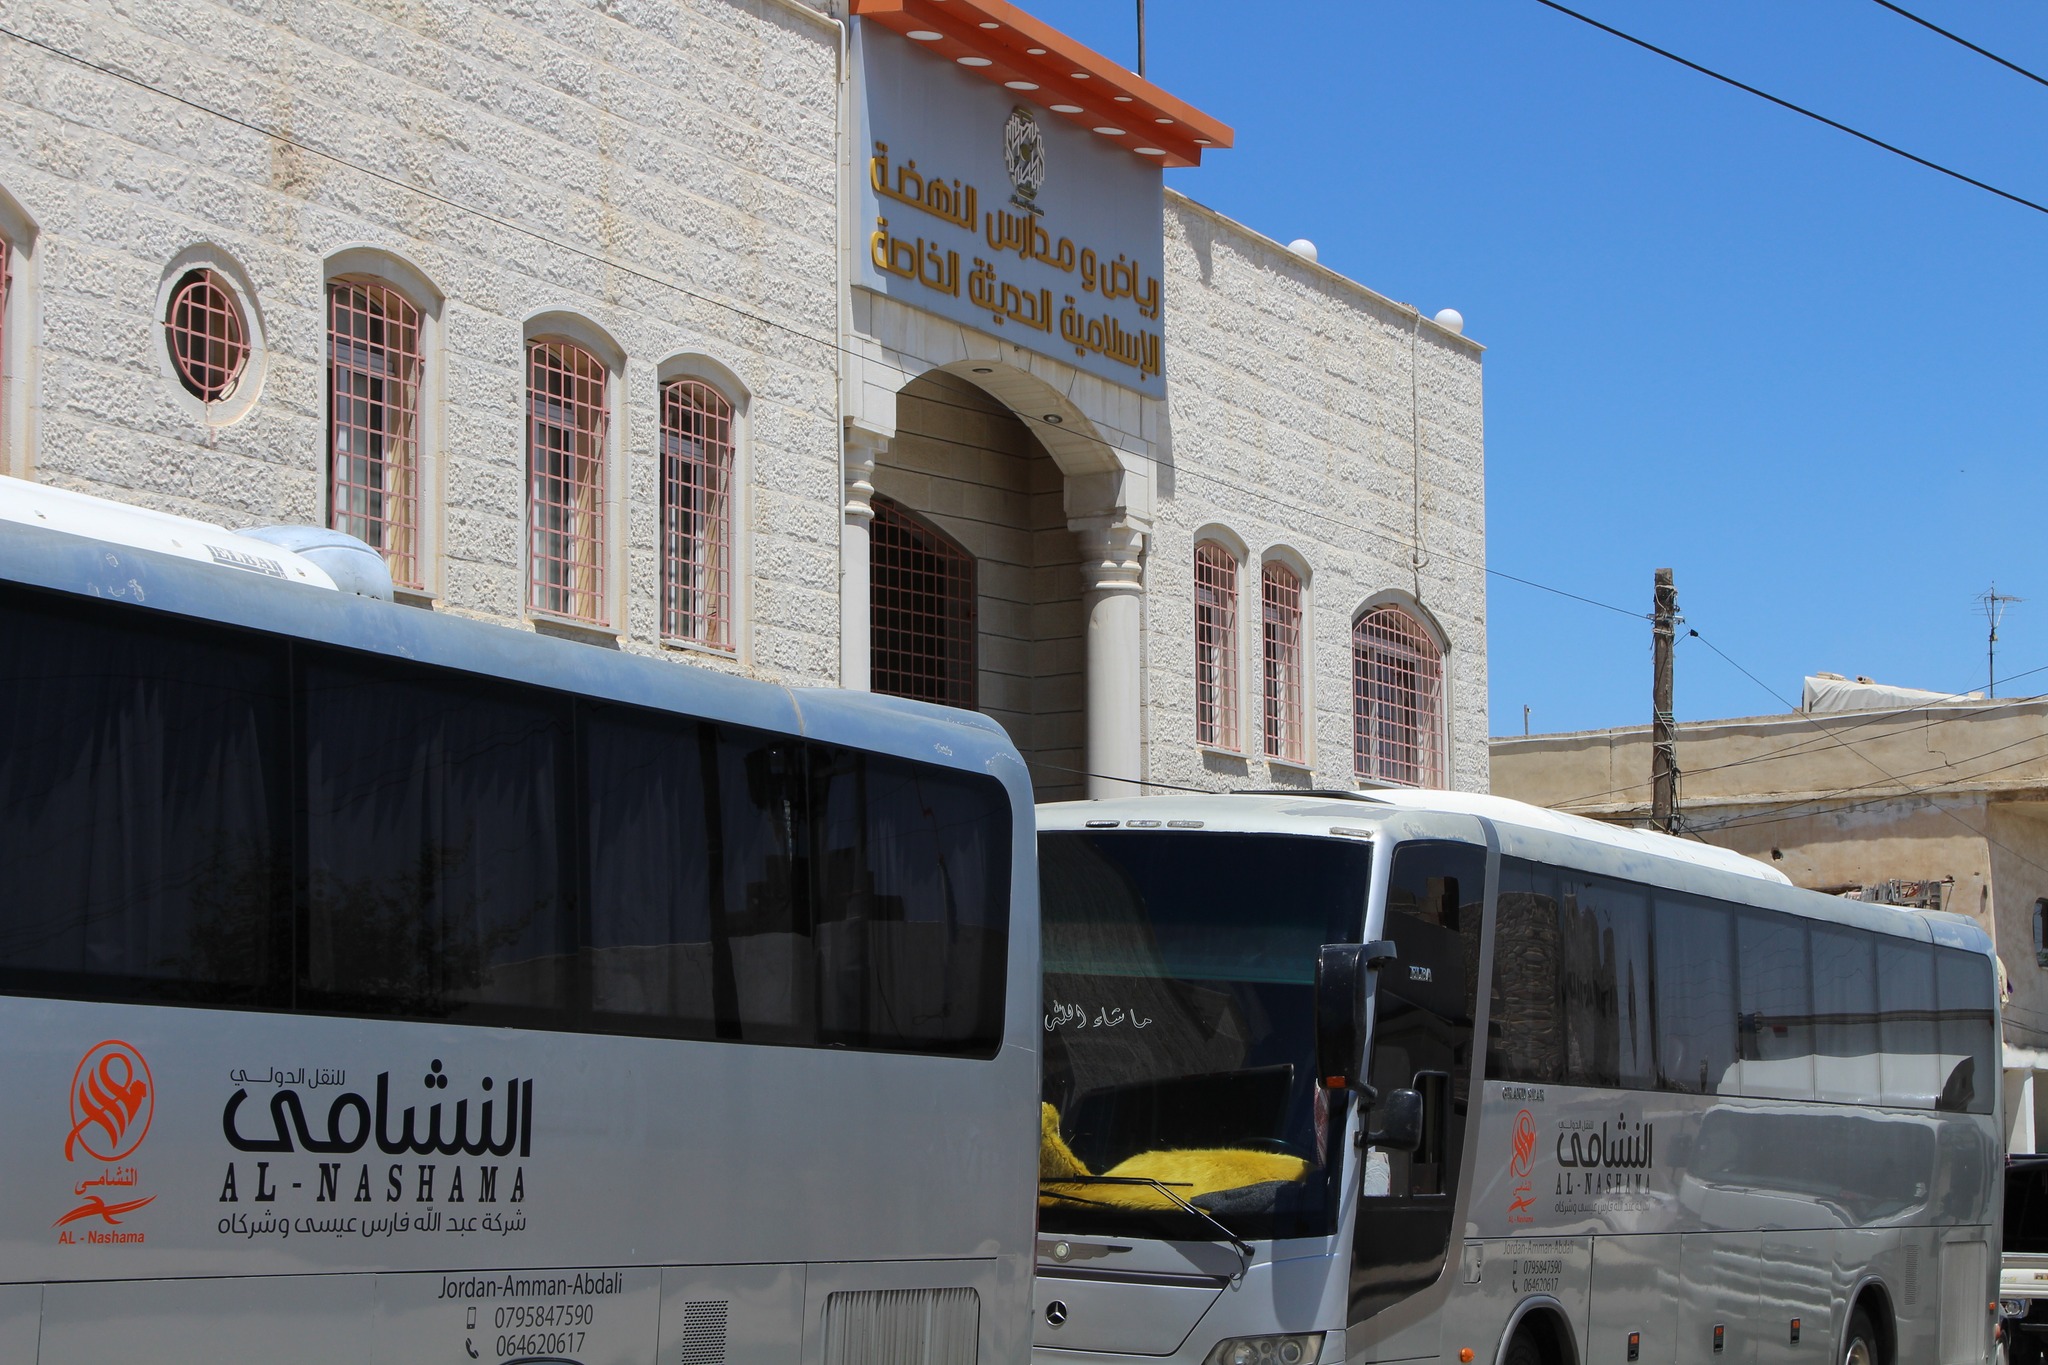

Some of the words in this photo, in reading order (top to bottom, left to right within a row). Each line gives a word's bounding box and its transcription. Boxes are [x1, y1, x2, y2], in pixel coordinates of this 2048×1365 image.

[870, 141, 978, 233] النهضة
[986, 209, 1075, 273] مدارس
[871, 216, 960, 299] الخاصة
[1080, 248, 1097, 292] و
[968, 256, 1053, 334] الحديثة
[1101, 253, 1159, 320] رياض
[1060, 294, 1161, 381] الإسلامية
[1044, 1000, 1087, 1032] الله
[1093, 1006, 1125, 1028] شاء
[1129, 1008, 1153, 1029] ما
[230, 1066, 305, 1088] الدولي
[308, 1069, 345, 1089] للنقل
[218, 1161, 526, 1203] AL-NASHAMA
[217, 1208, 291, 1240] وشركاه
[294, 1217, 357, 1239] عيسى
[361, 1211, 410, 1238] فارس
[414, 1206, 441, 1232] الله
[446, 1217, 477, 1237] عبد
[482, 1209, 526, 1237] شركة
[58, 1231, 77, 1245] AL
[87, 1230, 146, 1245] Nashama
[1523, 1260, 1563, 1275] 0795847590
[438, 1271, 623, 1300] Jordan-Amman-Abdali
[1523, 1277, 1559, 1292] 064620617
[494, 1303, 594, 1330] 0795847590
[495, 1331, 586, 1357] 064620617
